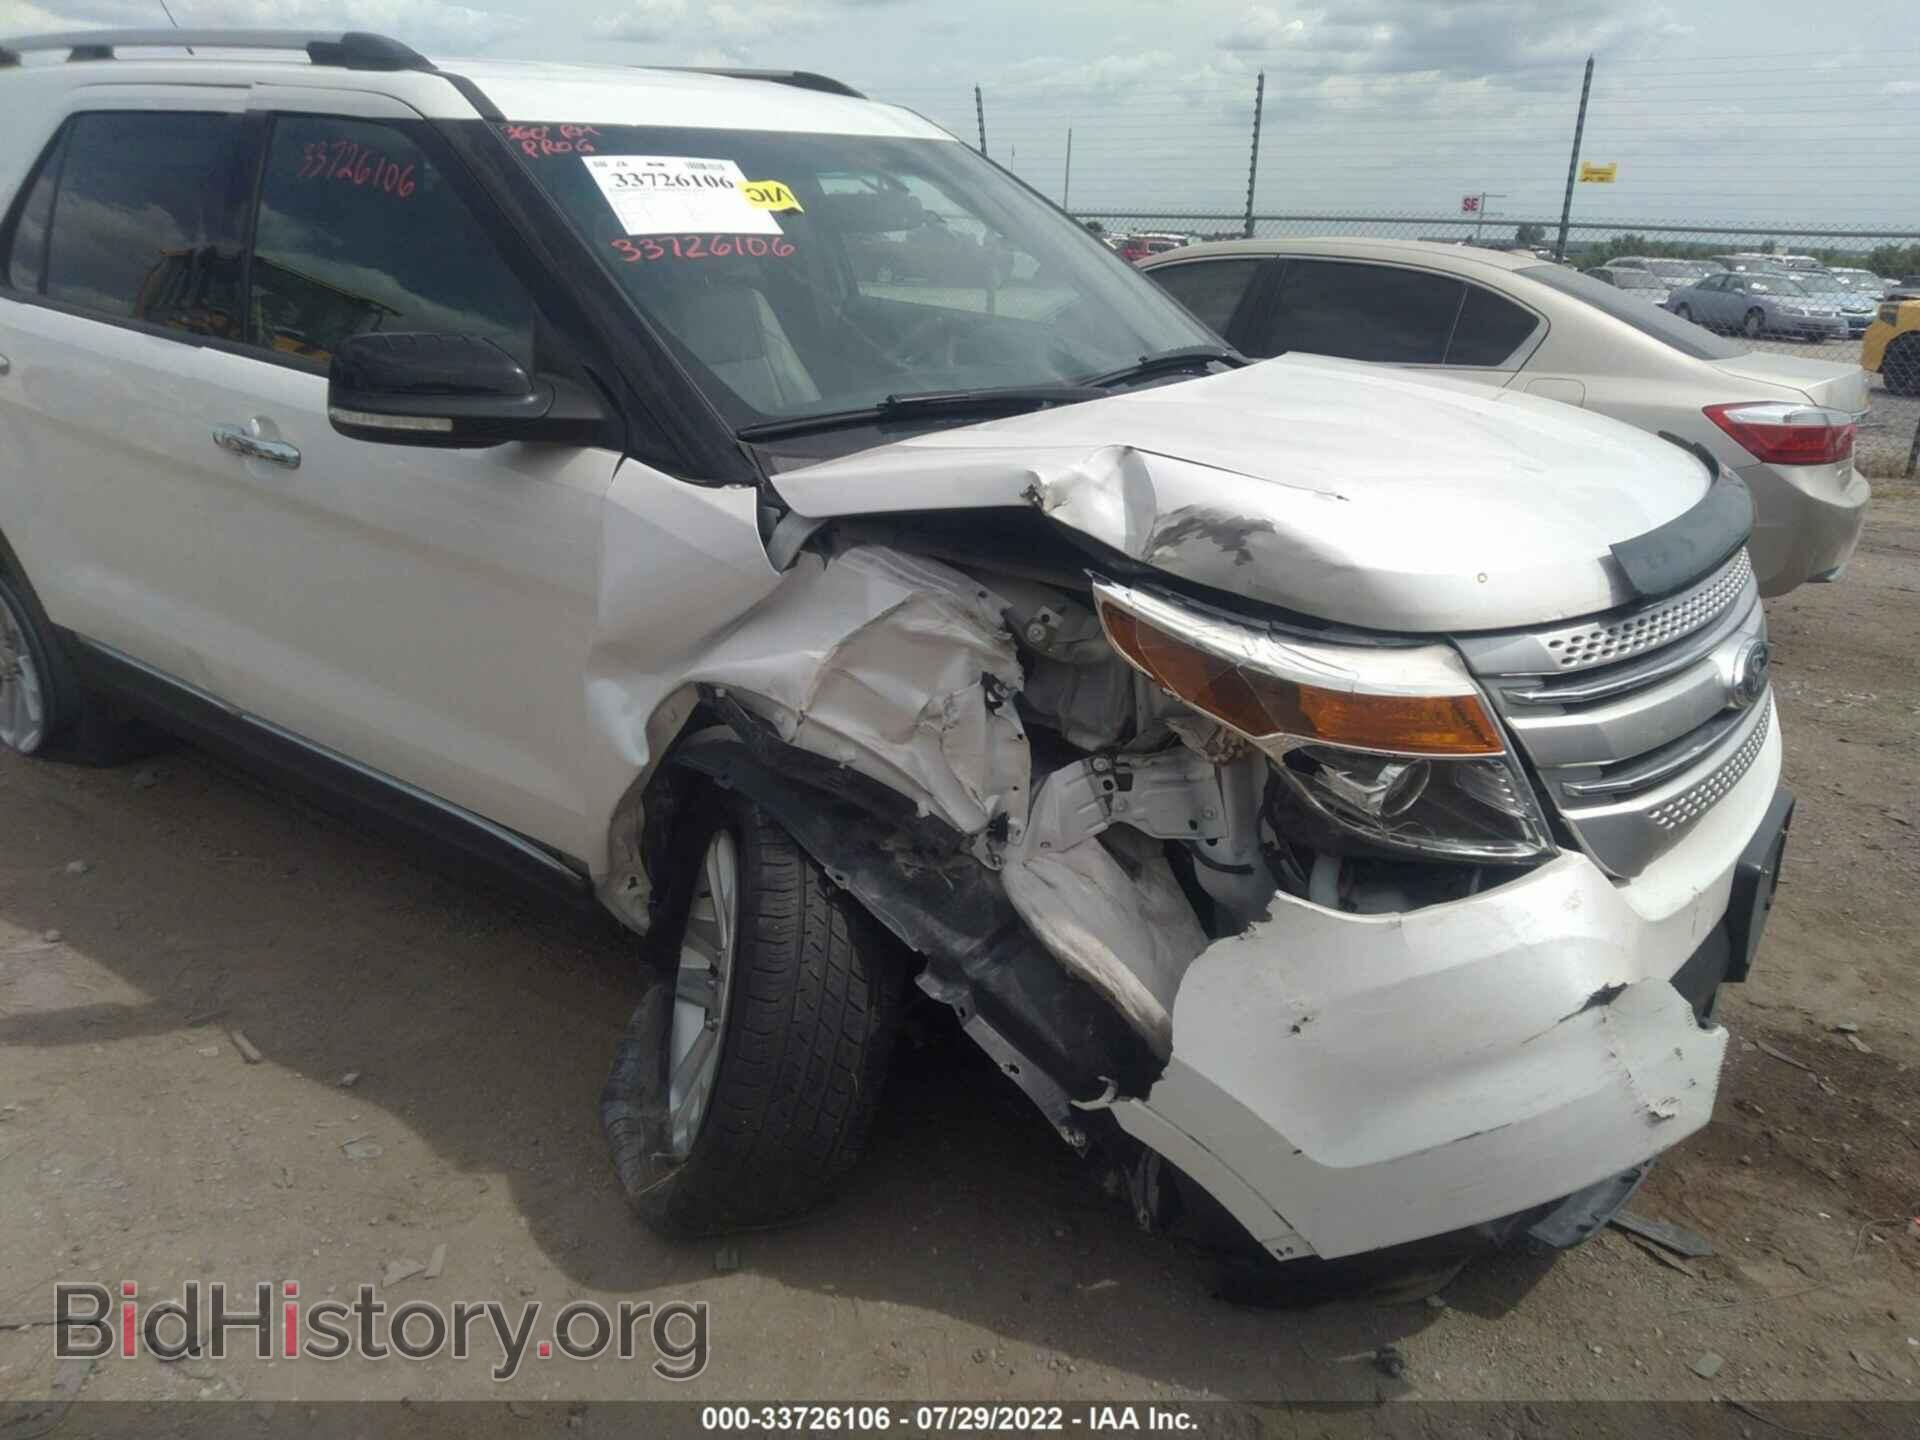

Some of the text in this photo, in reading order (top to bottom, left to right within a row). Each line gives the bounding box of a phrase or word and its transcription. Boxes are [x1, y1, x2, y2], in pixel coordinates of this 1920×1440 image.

[297, 139, 417, 198] 33726106
[610, 171, 735, 190] 33726106
[1462, 197, 1479, 212] SE
[611, 234, 796, 263] 33726106
